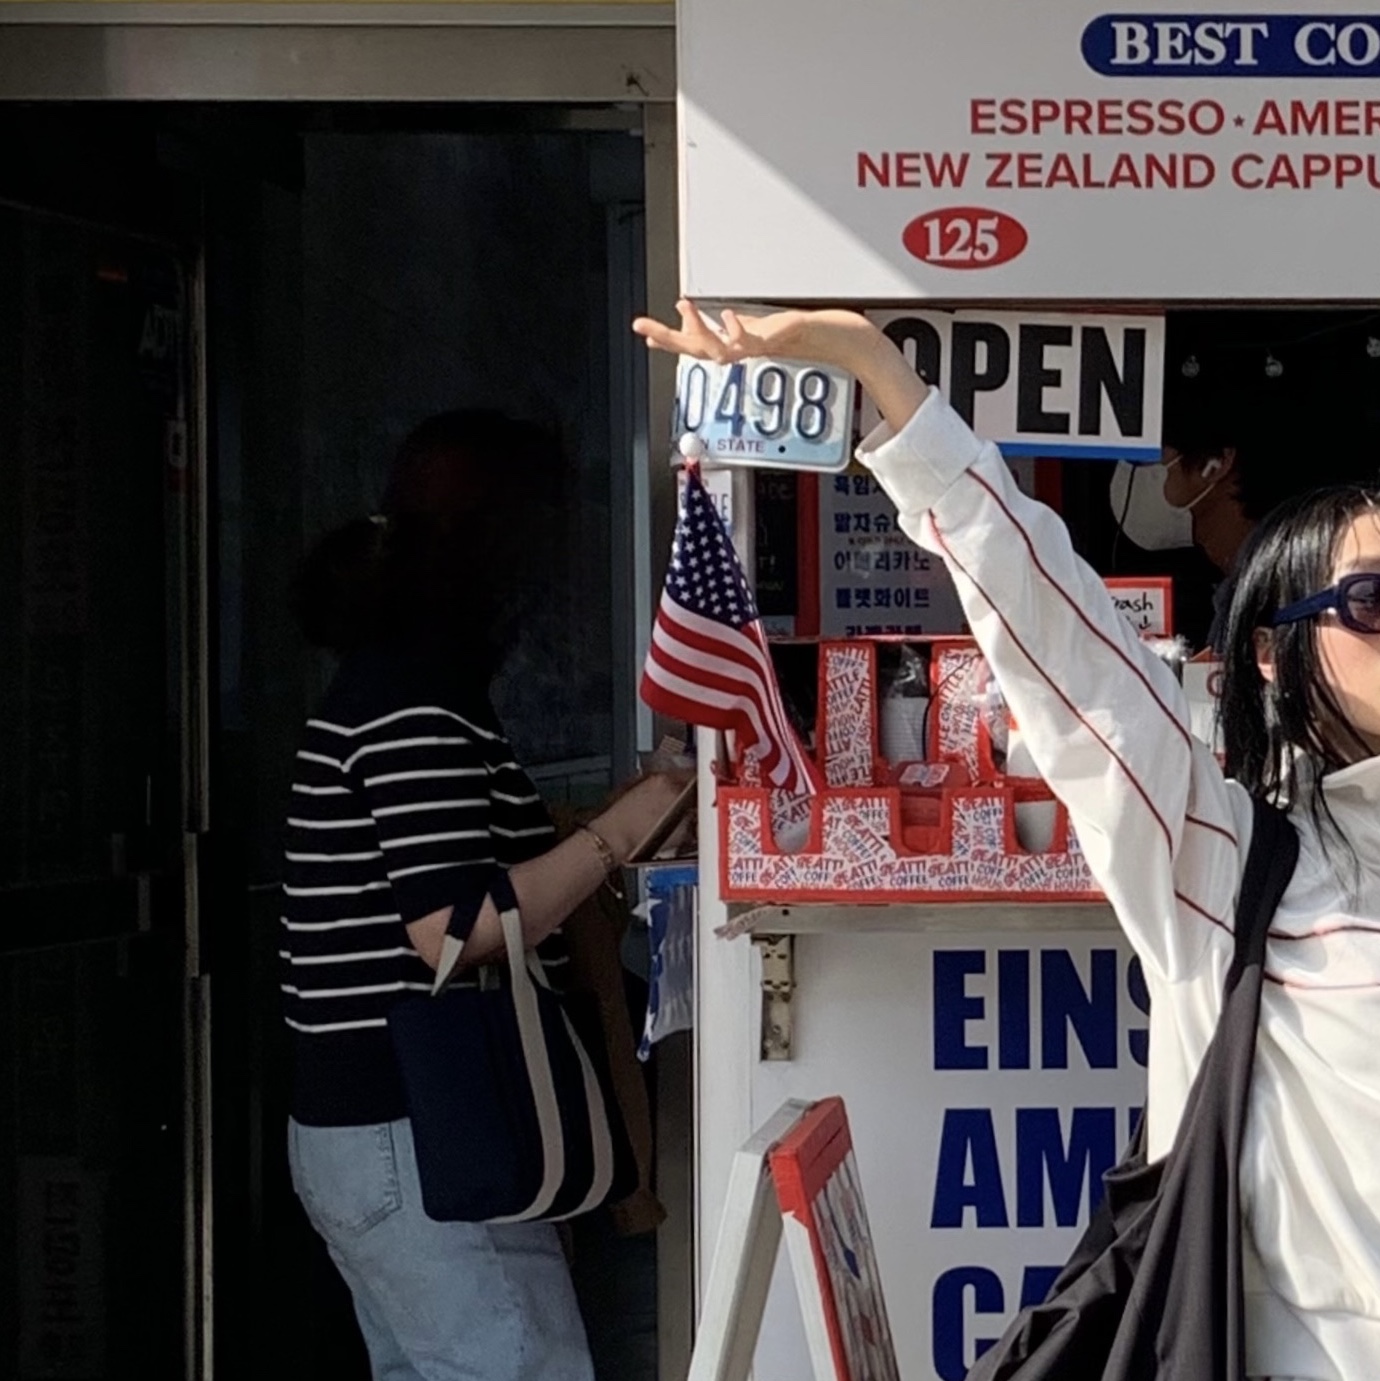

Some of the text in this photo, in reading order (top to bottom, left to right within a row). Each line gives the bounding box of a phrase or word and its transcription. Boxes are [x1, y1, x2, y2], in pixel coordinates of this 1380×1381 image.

[1110, 22, 1268, 65] BEST
[969, 99, 1226, 136] ESPRESSO
[856, 152, 971, 188] NEW
[986, 152, 1217, 189] ZEALAND
[924, 219, 1000, 261] 125
[716, 438, 768, 454] STATE
